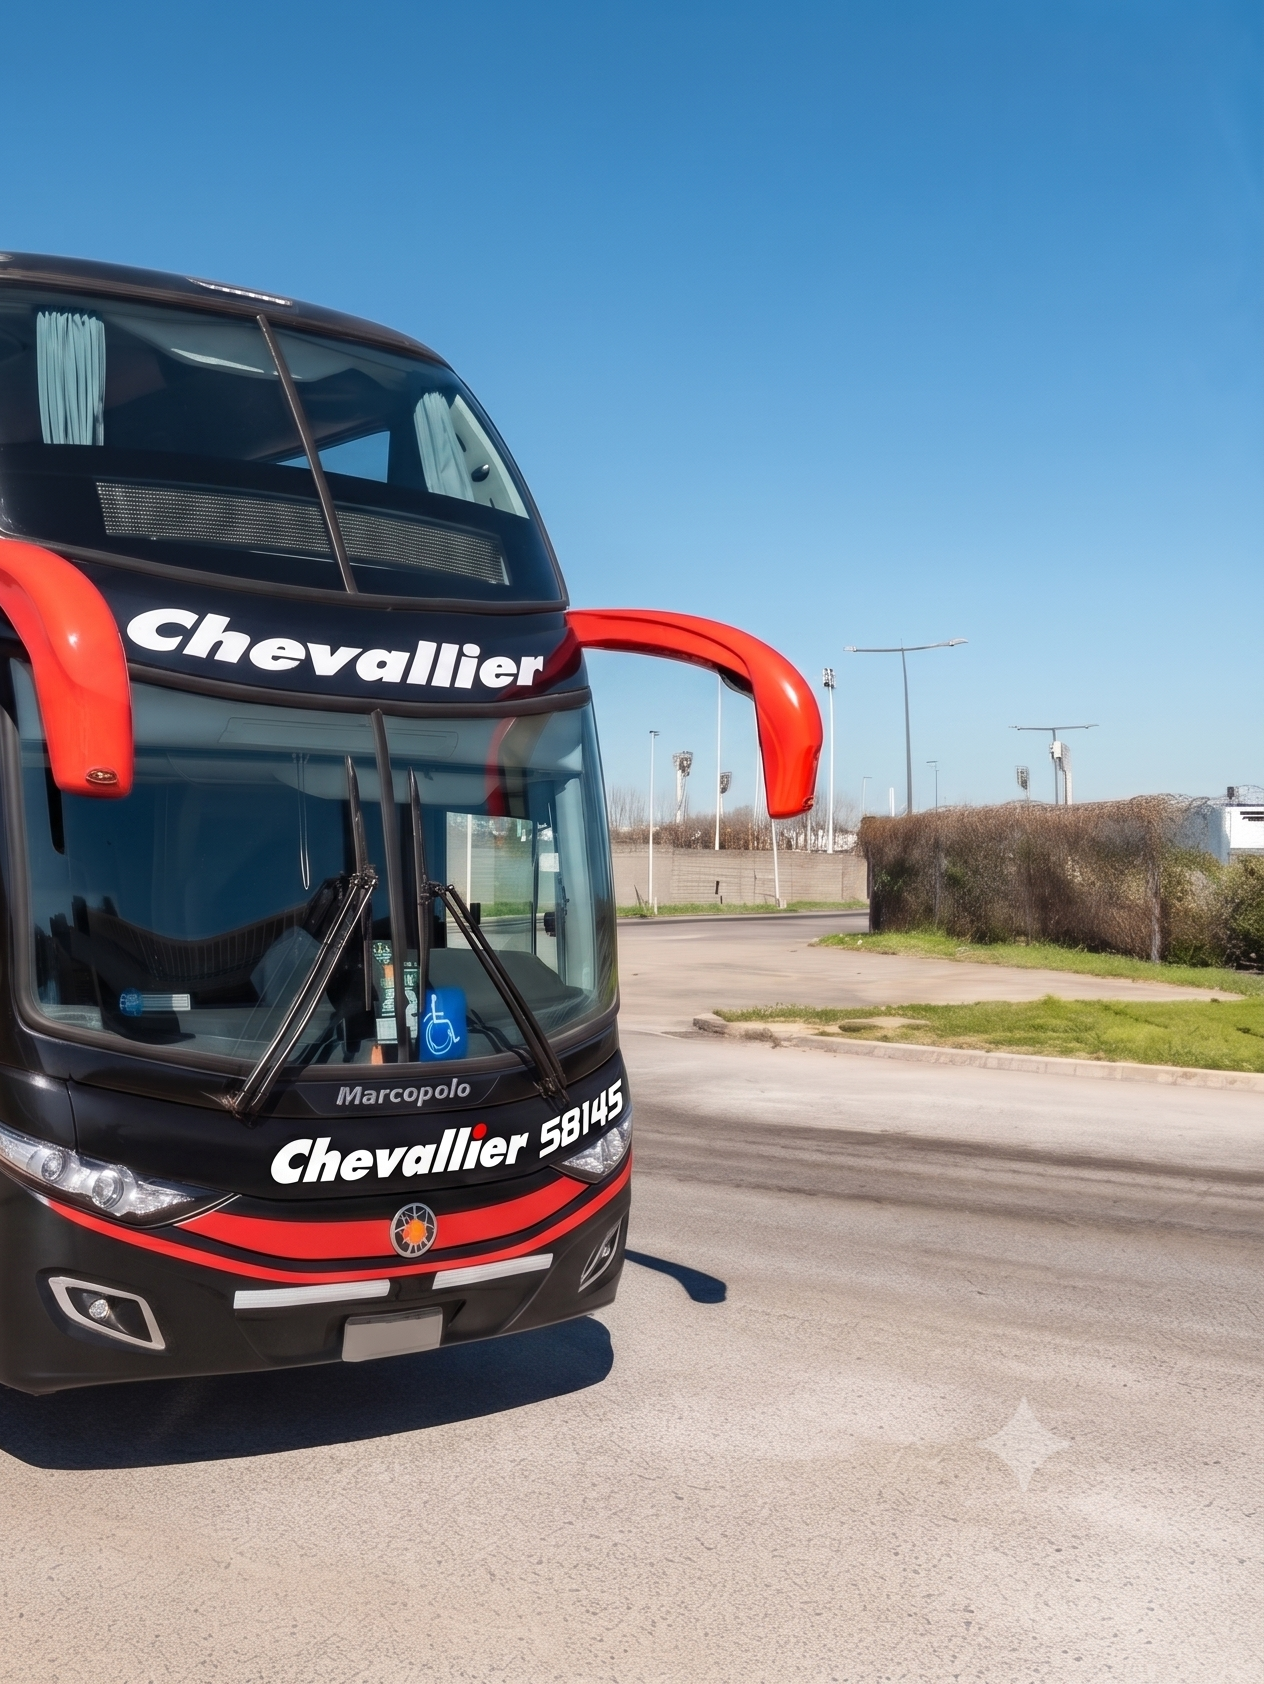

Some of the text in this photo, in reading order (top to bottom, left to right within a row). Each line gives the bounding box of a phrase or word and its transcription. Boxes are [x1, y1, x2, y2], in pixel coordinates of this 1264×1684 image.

[126, 608, 544, 689] Chevallier
[270, 1078, 623, 1185] Chevallier 58145
[336, 1077, 471, 1107] Marcopolo
